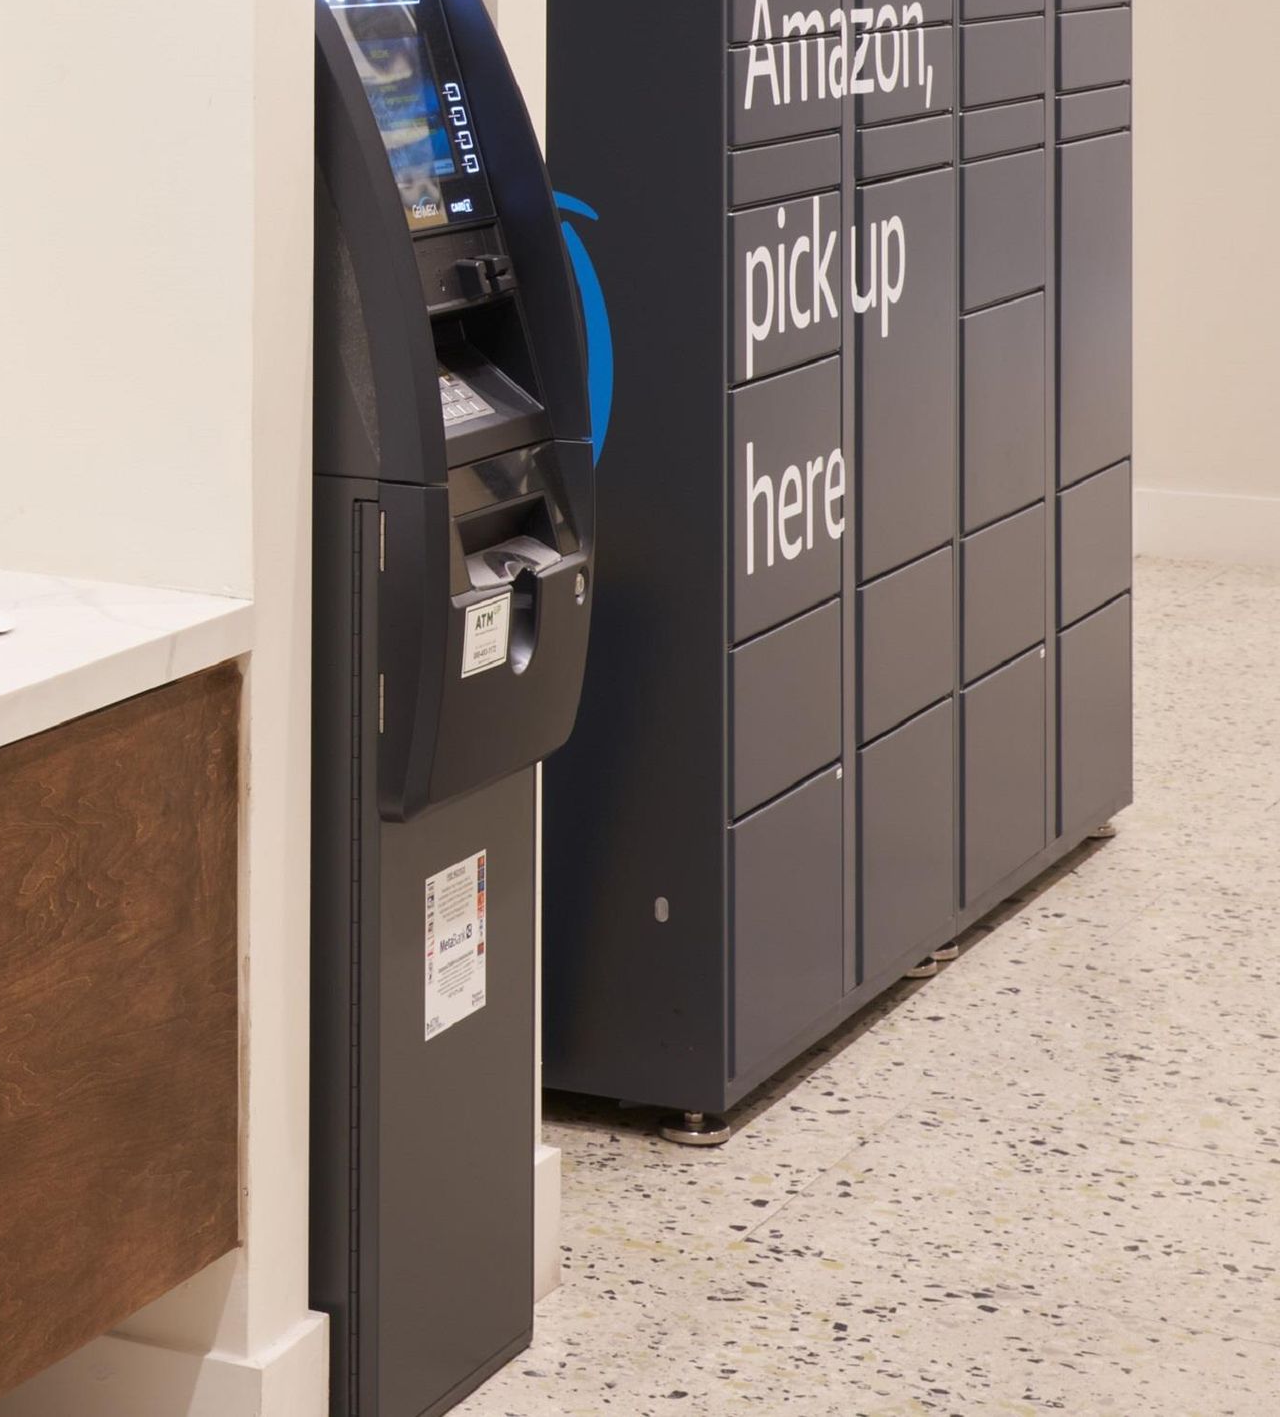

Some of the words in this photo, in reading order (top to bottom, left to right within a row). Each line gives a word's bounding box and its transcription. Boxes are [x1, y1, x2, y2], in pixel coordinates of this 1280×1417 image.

[746, 196, 838, 379] pick
[851, 215, 906, 338] up
[746, 442, 846, 575] here
[475, 611, 494, 630] ATM
